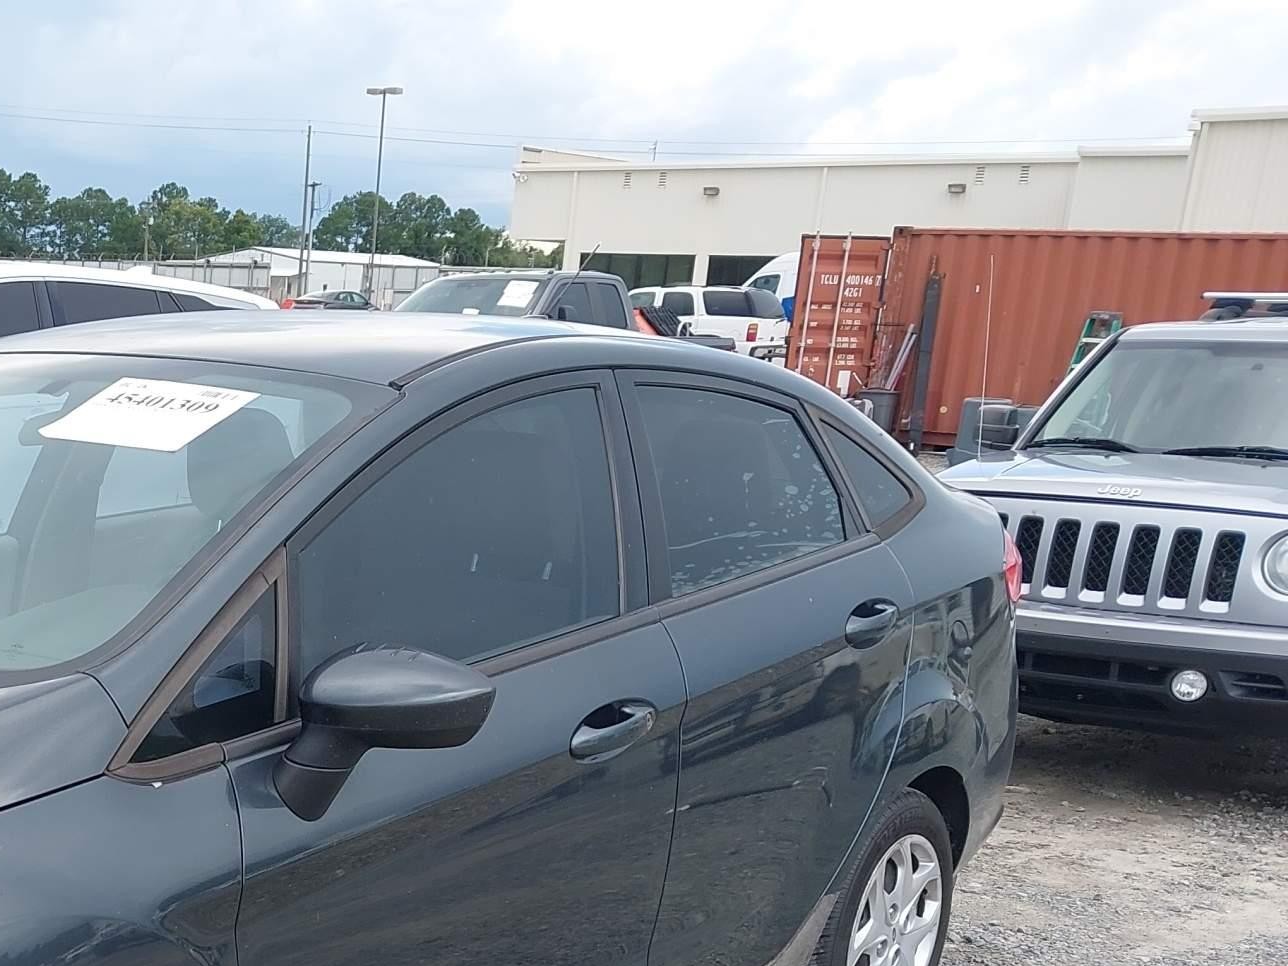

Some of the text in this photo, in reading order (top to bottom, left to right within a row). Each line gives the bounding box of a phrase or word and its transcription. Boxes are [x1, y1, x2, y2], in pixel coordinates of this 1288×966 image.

[820, 274, 840, 285] TCLU
[845, 274, 874, 286] 400146
[843, 287, 863, 298] 42G1
[1096, 484, 1143, 498] Jeep
